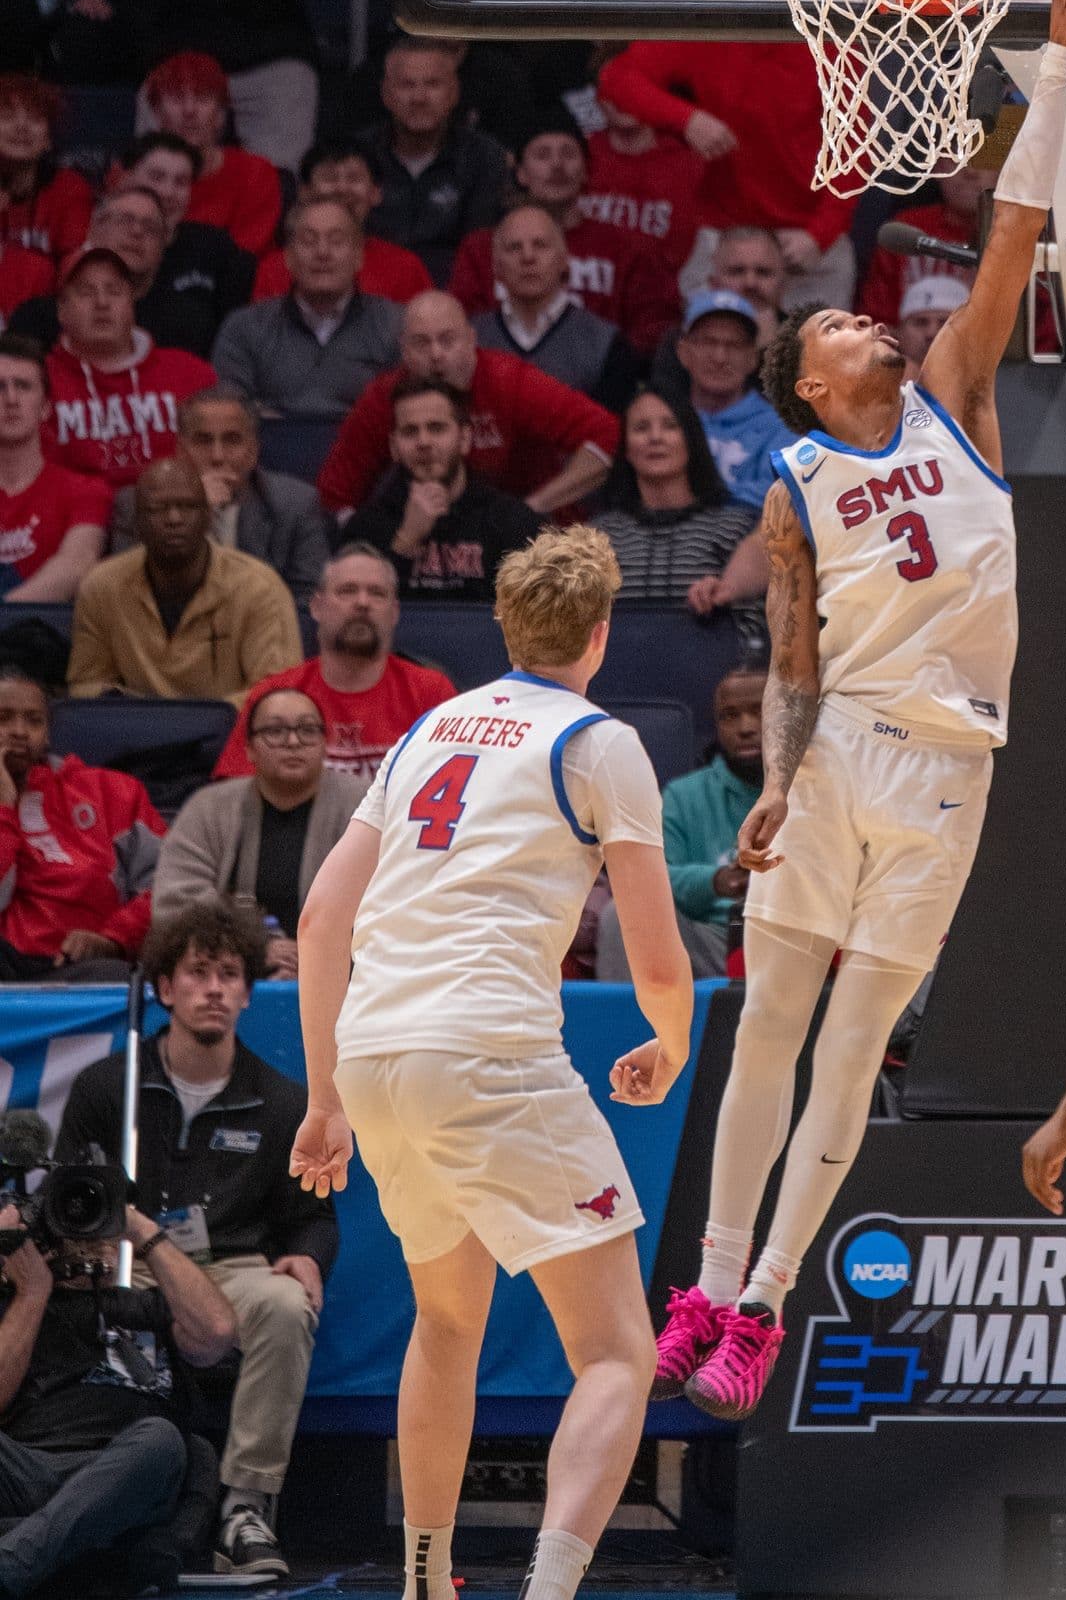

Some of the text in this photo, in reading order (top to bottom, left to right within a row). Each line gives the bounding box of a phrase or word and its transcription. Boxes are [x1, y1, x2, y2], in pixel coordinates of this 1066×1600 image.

[56, 392, 178, 445] MIAMI
[836, 459, 944, 531] SMU
[886, 510, 939, 583] 3
[428, 716, 533, 749] WALTERS
[873, 721, 910, 741] SMU
[408, 753, 480, 851] 4
[850, 1263, 909, 1282] NCAA
